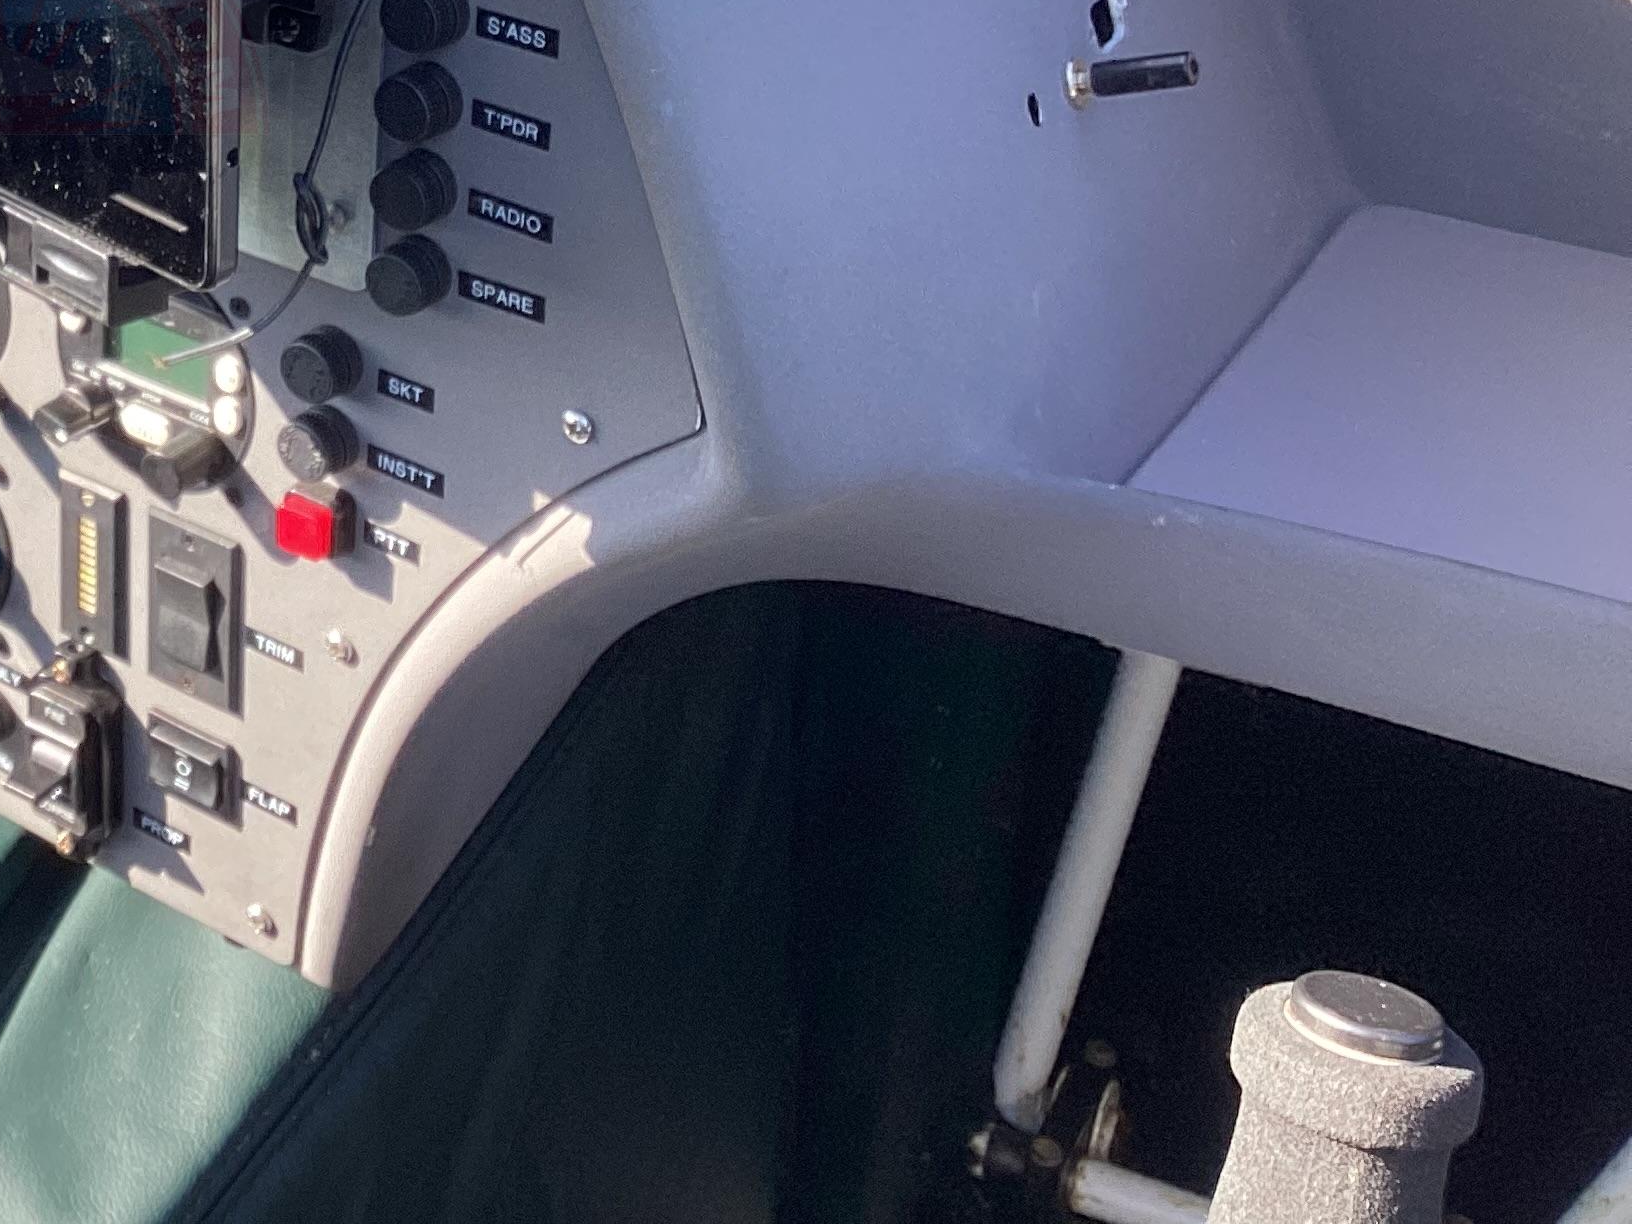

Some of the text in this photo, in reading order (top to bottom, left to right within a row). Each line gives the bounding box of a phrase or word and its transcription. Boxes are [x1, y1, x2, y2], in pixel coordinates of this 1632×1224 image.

[487, 16, 546, 49] S'ASS
[484, 108, 539, 141] T'PDR
[481, 198, 542, 234] RADIO
[471, 279, 534, 315] SPARE
[388, 377, 424, 403] SKT
[377, 454, 435, 489] INST'T
[373, 529, 410, 556] PTT
[255, 635, 296, 665] TRIM
[248, 787, 290, 817] FLAP
[141, 816, 184, 845] PROP
